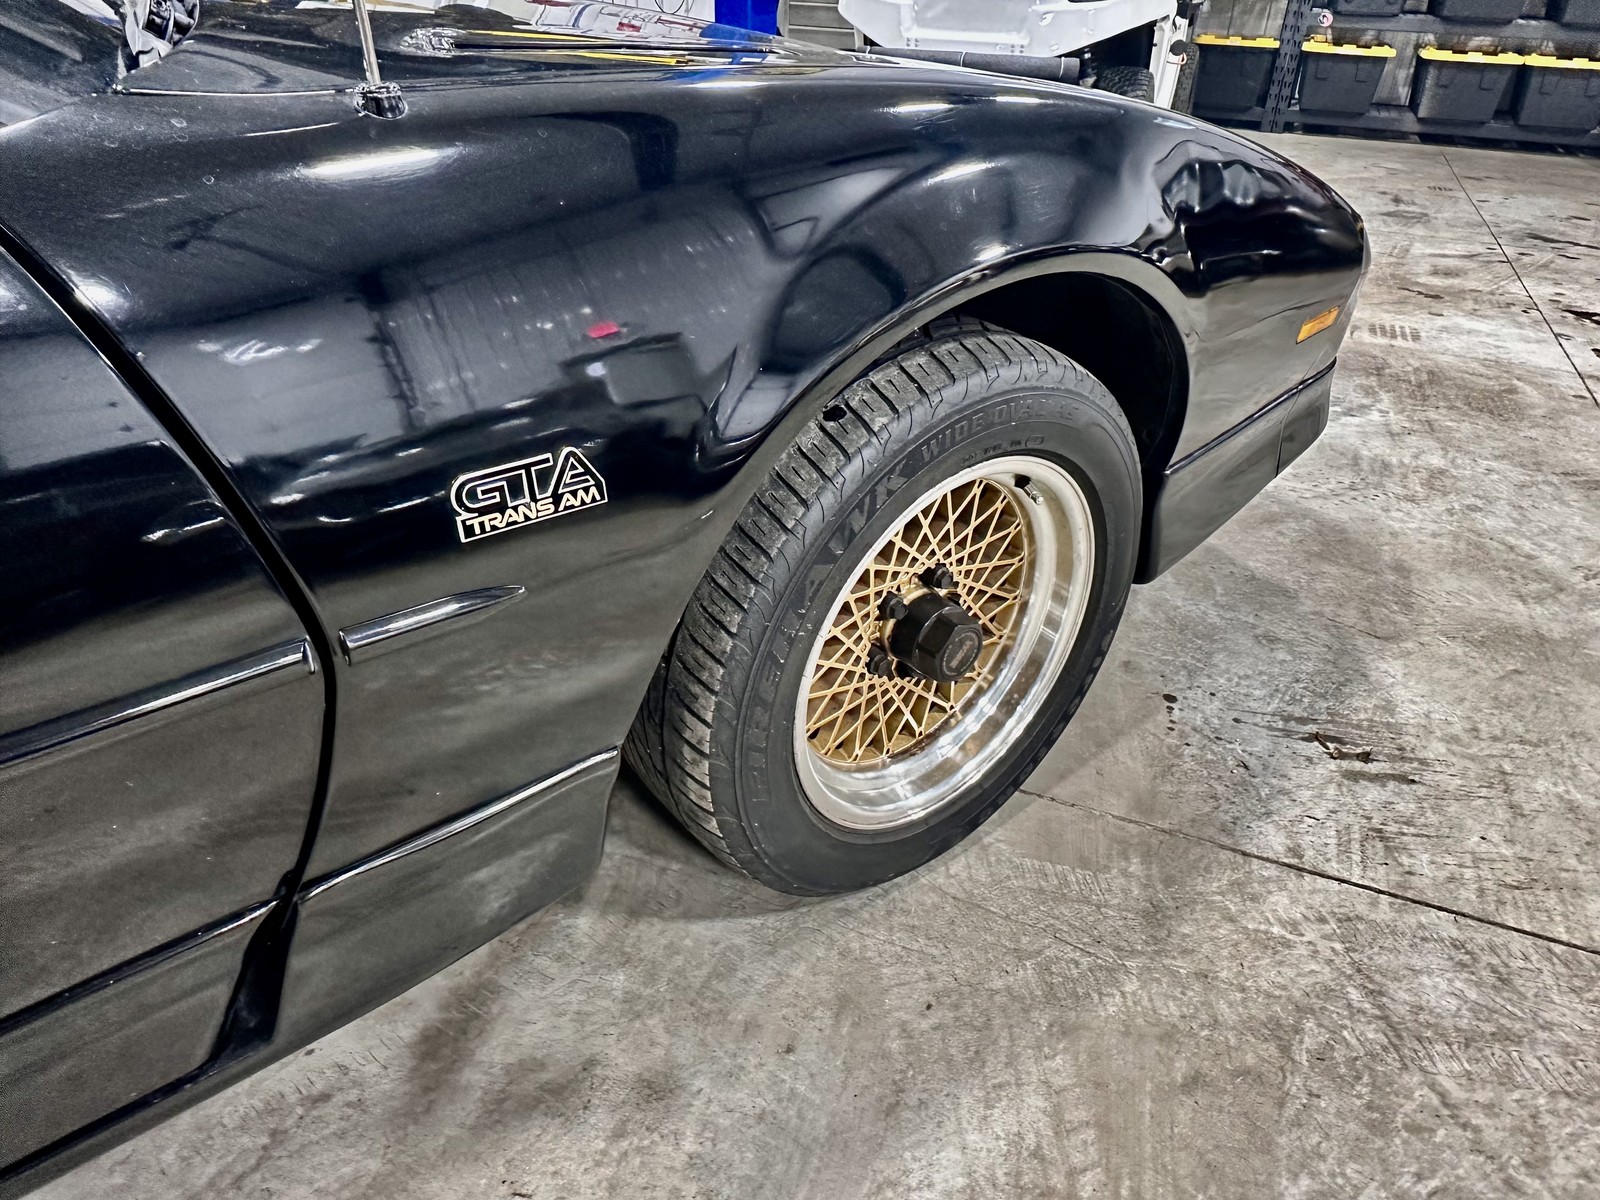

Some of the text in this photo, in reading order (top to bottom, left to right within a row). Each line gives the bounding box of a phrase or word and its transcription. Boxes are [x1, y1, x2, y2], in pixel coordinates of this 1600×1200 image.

[921, 412, 985, 462] WIDE
[450, 446, 602, 516] GTA
[465, 485, 601, 536] TRANS AM
